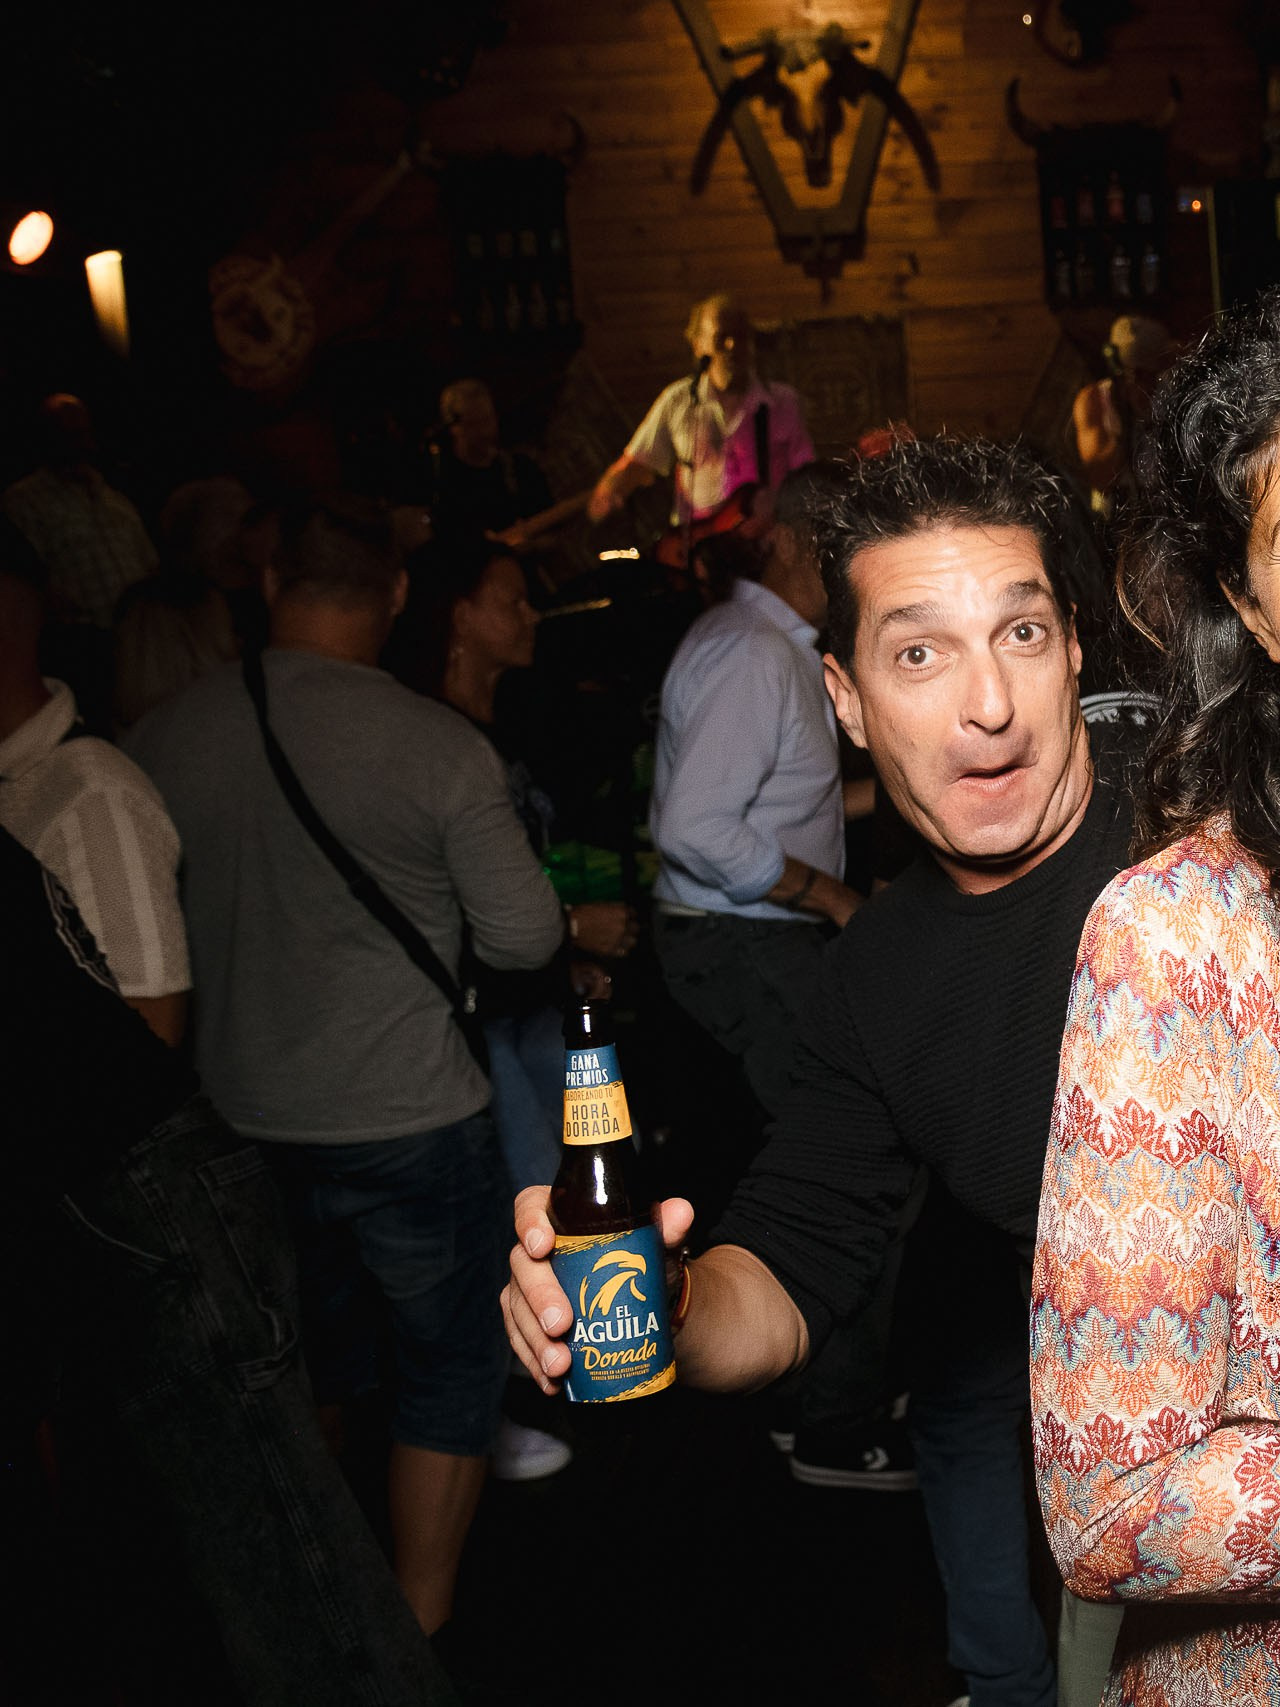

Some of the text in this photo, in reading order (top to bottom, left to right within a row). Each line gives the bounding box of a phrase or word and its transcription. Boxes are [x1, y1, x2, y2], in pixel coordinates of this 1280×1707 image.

[571, 1054, 600, 1070] GANA
[566, 1069, 609, 1086] PREMIOS
[605, 1087, 613, 1098] TU
[572, 1102, 609, 1120] HORA
[566, 1117, 620, 1137] DORADA
[616, 1305, 631, 1318] EL
[573, 1312, 659, 1343] ÁGUILA
[580, 1338, 657, 1370] Dorada
